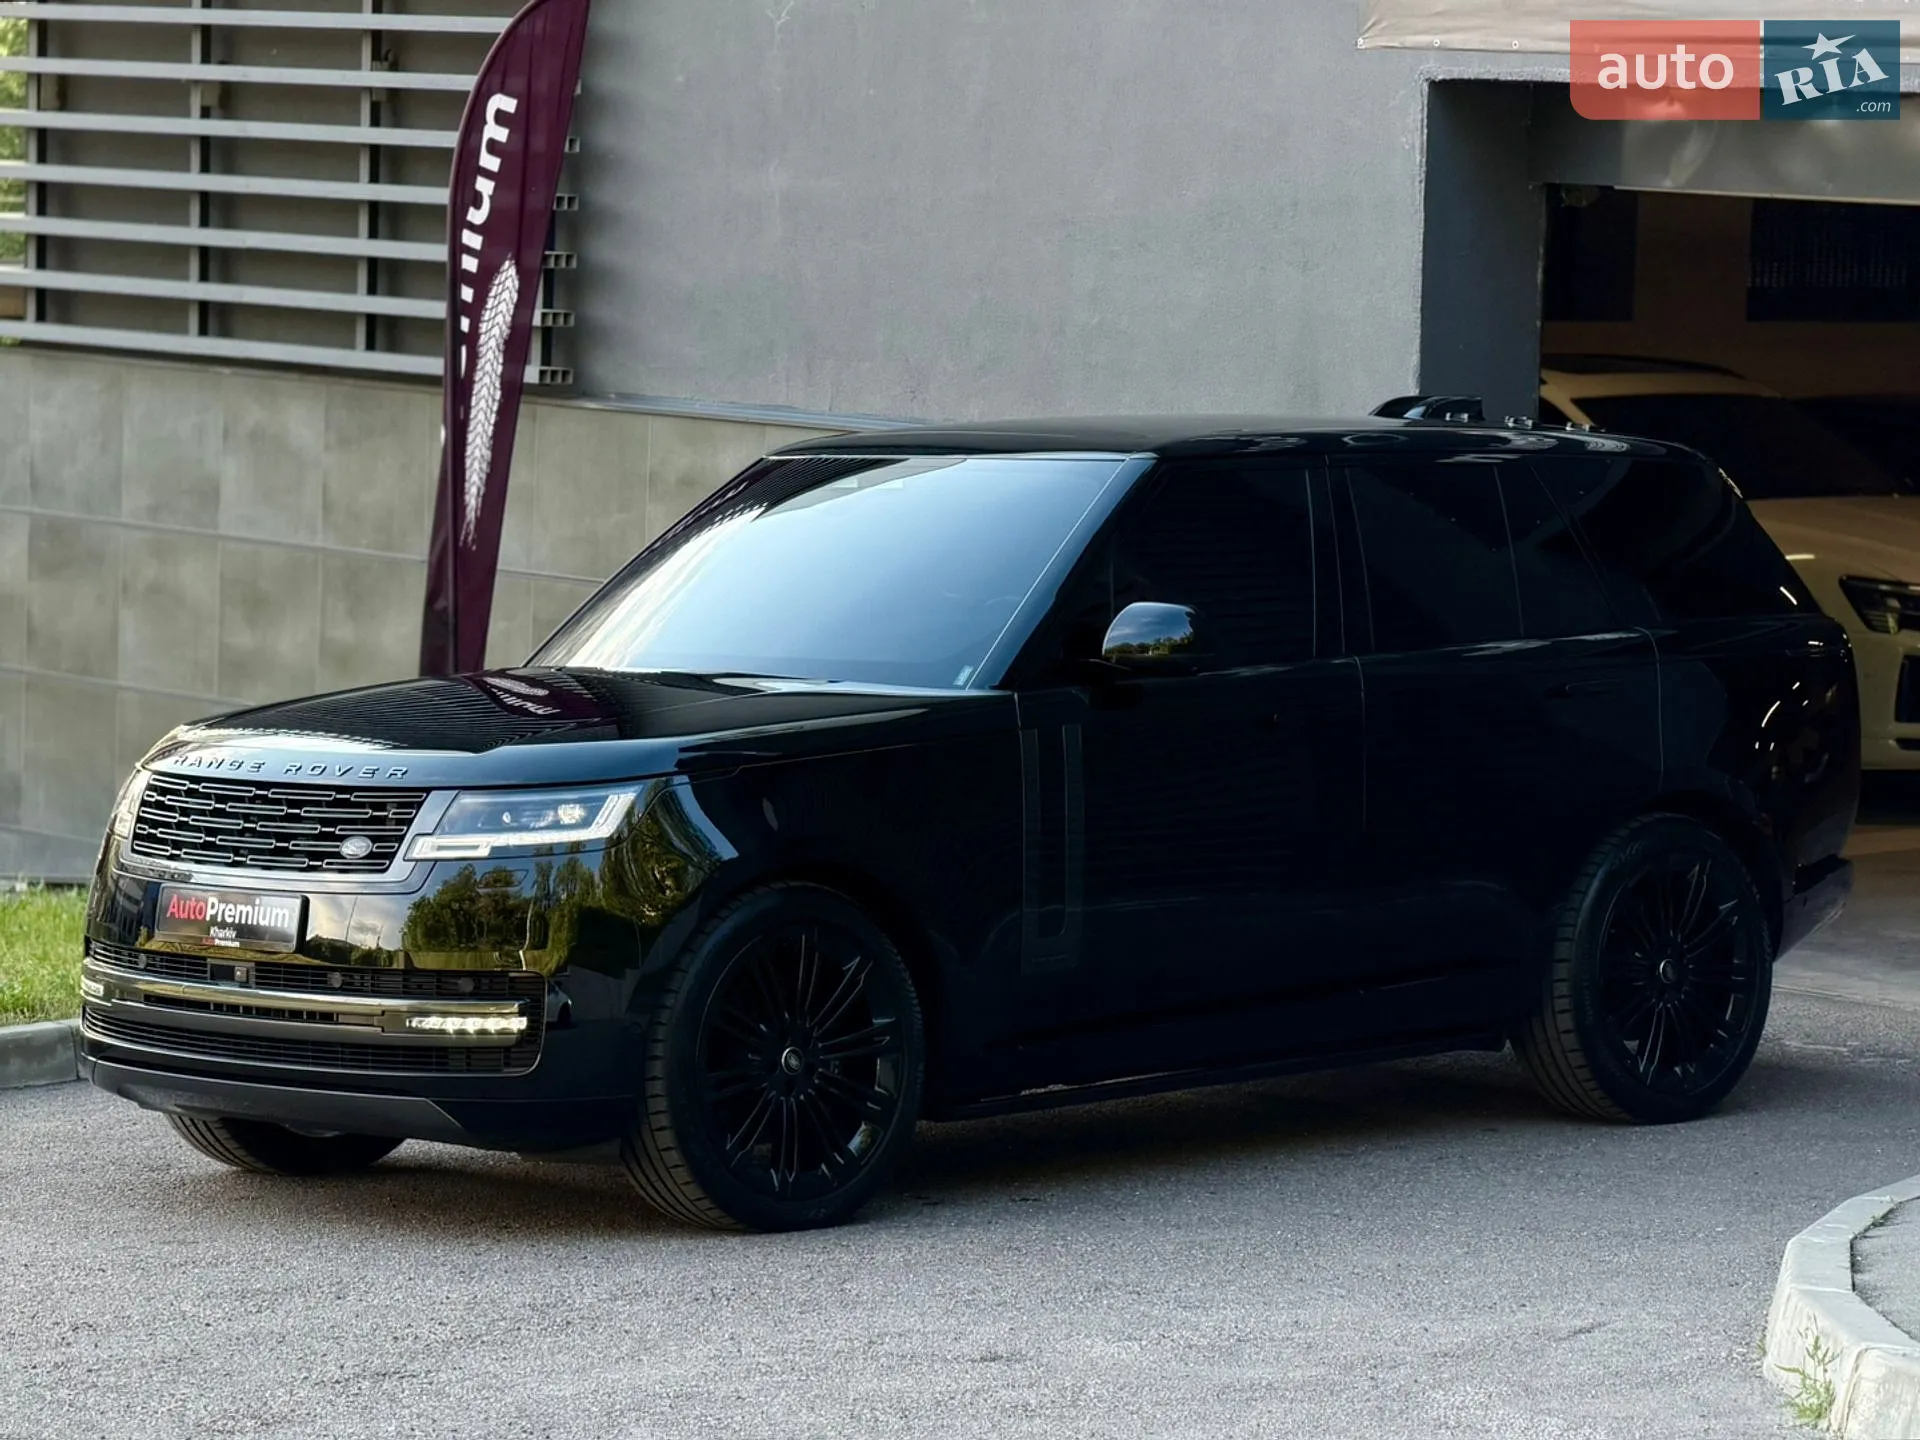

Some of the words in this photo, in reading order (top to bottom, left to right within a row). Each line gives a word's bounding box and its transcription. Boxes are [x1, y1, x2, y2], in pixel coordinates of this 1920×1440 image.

[173, 755, 265, 774] RANGE
[283, 761, 409, 780] ROVER
[166, 894, 289, 928] AutoPremium
